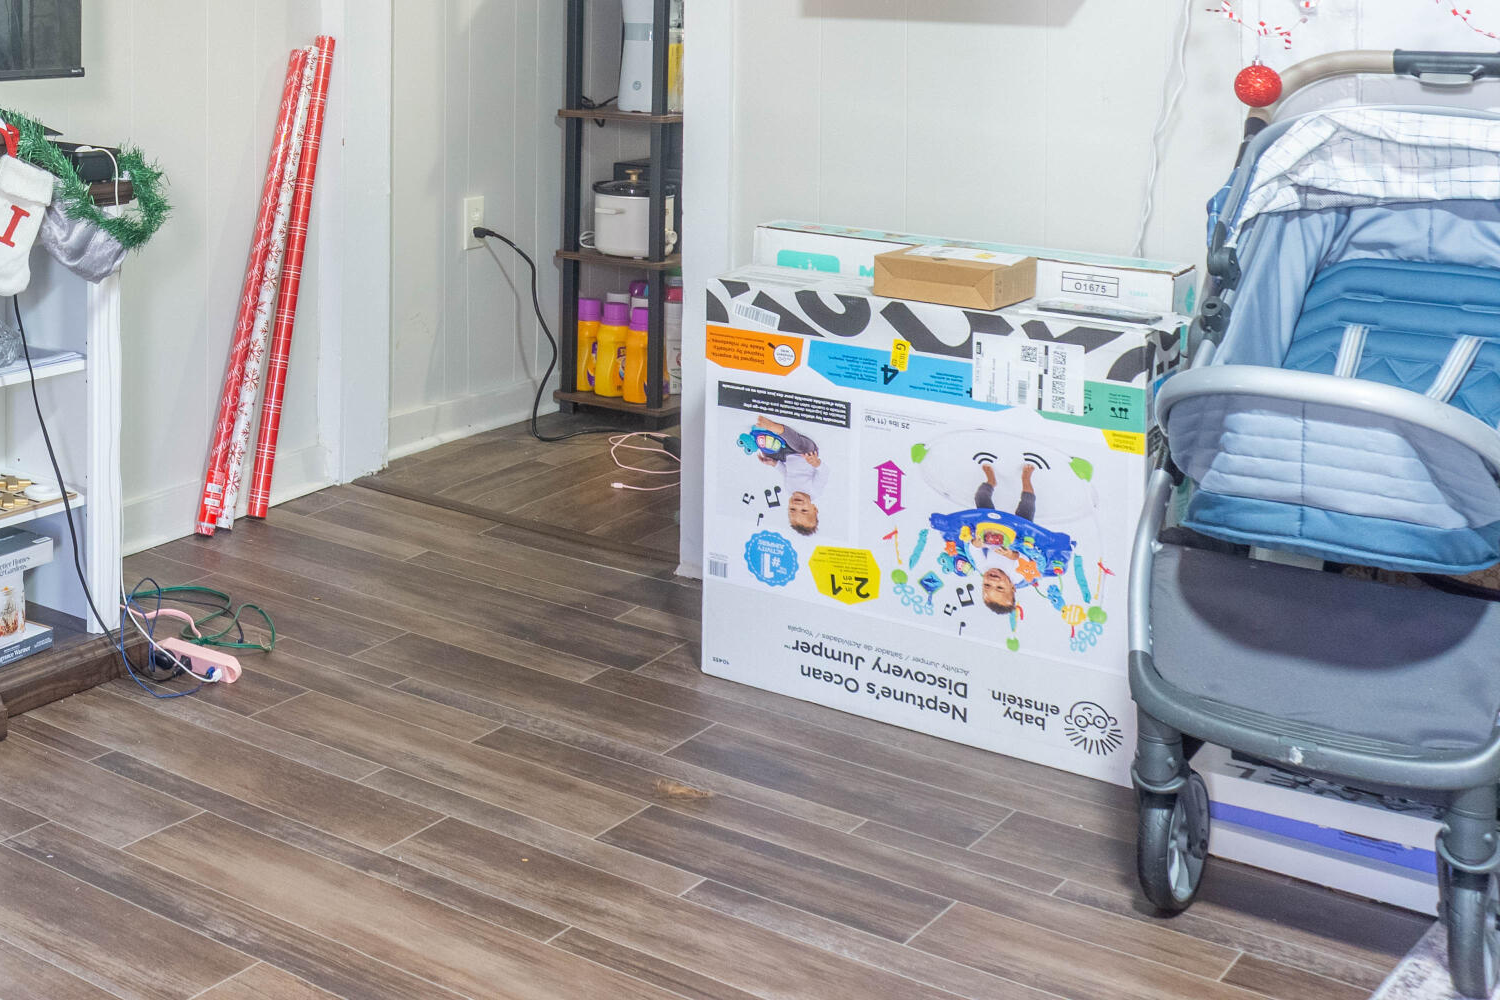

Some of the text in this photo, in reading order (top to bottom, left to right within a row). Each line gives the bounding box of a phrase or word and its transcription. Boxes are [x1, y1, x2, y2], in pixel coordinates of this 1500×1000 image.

[881, 365, 899, 385] 4
[864, 415, 876, 423] kg)
[877, 417, 887, 425] (11
[889, 420, 899, 428] lbs
[901, 422, 910, 430] 25
[883, 494, 897, 509] 4
[757, 545, 784, 555] ACTIVITY
[830, 574, 843, 596] 1
[854, 576, 870, 599] 2
[822, 632, 862, 651] Actividades
[864, 643, 873, 653] de
[874, 646, 903, 661] Saltador
[911, 655, 940, 672] Jumper
[941, 661, 969, 678] Activity
[800, 664, 859, 694] Ocean
[872, 657, 968, 699] Discovery
[991, 689, 1060, 717] einstein
[1003, 706, 1046, 731] baby
